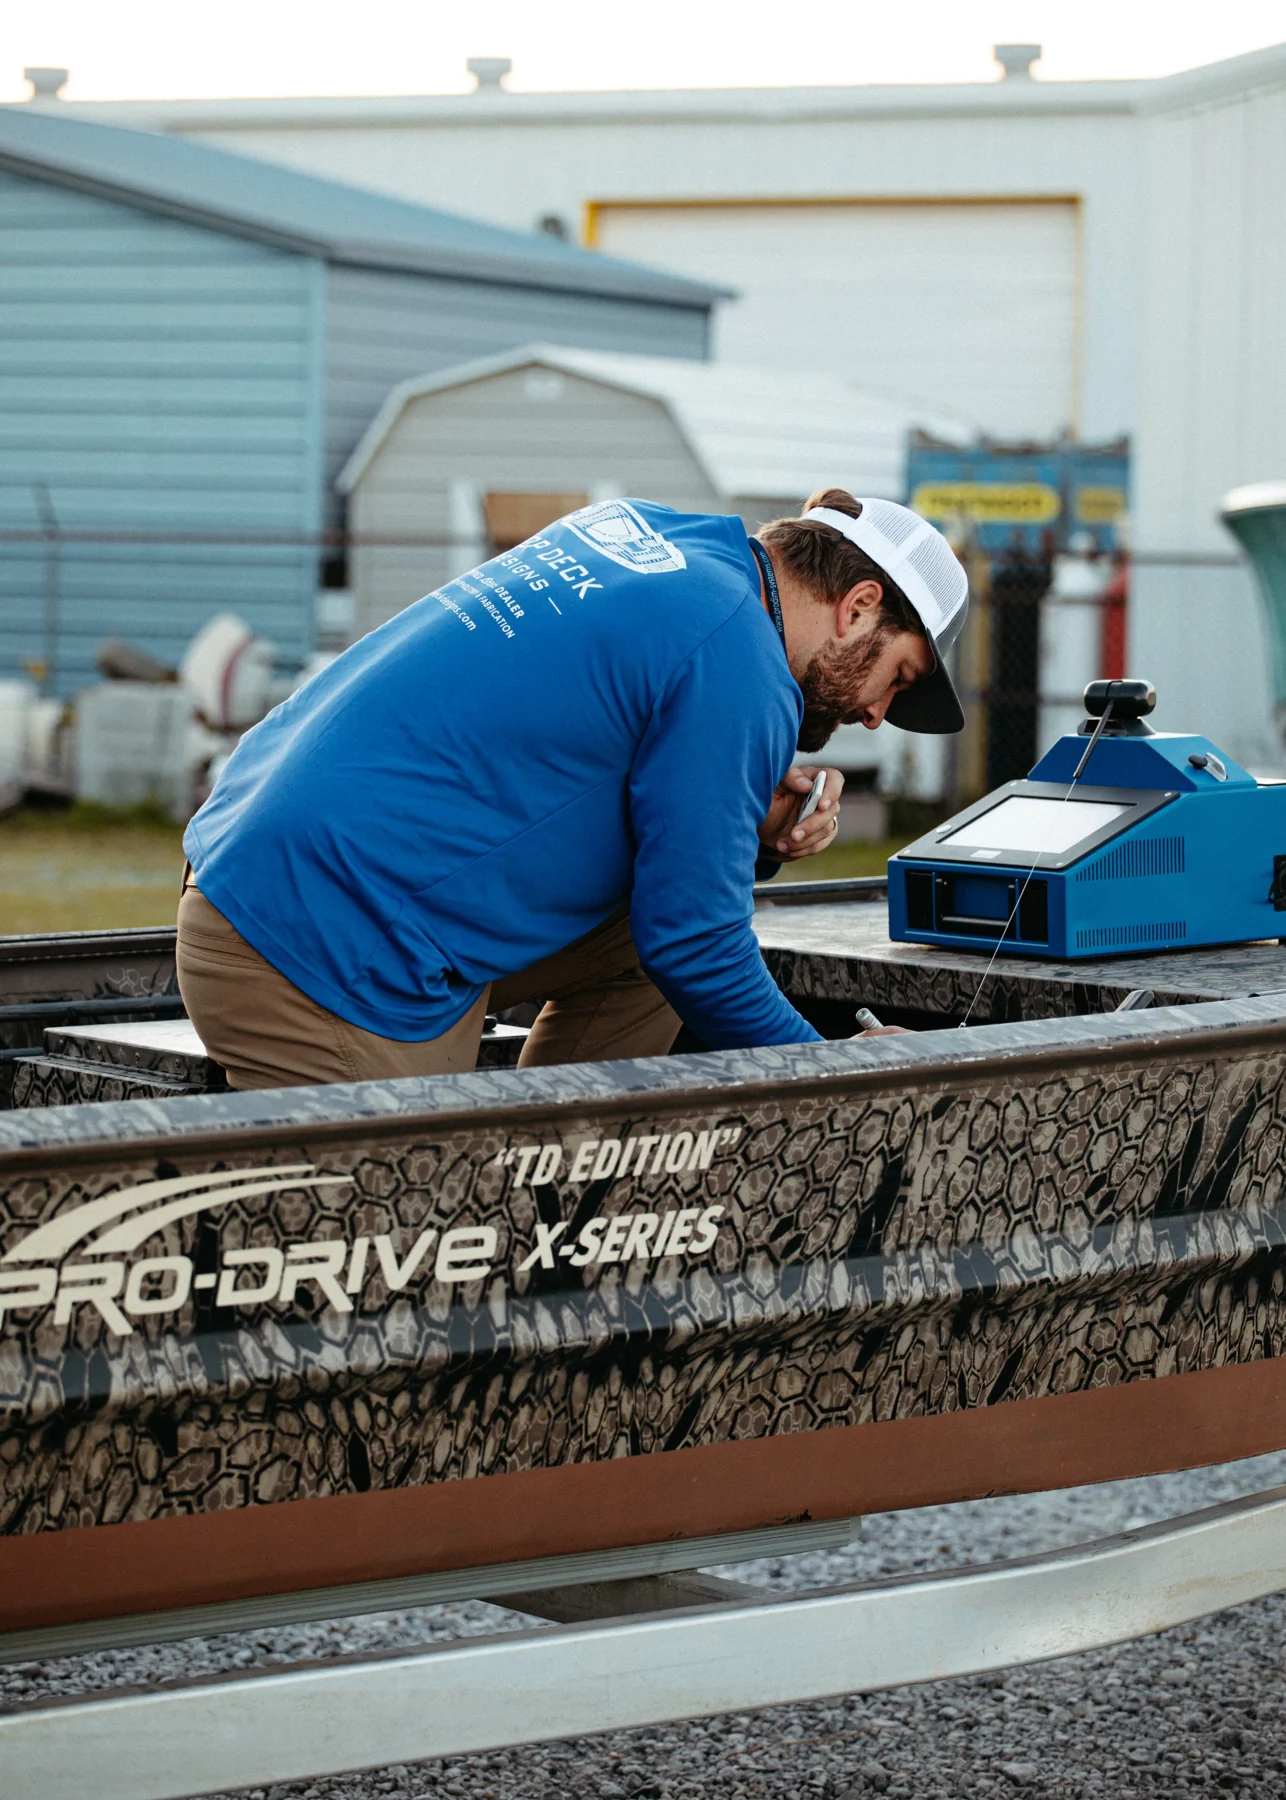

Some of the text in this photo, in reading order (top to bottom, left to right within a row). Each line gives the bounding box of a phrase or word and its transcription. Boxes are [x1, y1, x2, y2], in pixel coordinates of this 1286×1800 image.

[537, 548, 604, 600] DECK
[760, 550, 784, 633] www.prodim-systems.com
[478, 596, 516, 639] FABRICATION
[494, 586, 525, 619] DEALER
[516, 1205, 725, 1272] X-SERIES
